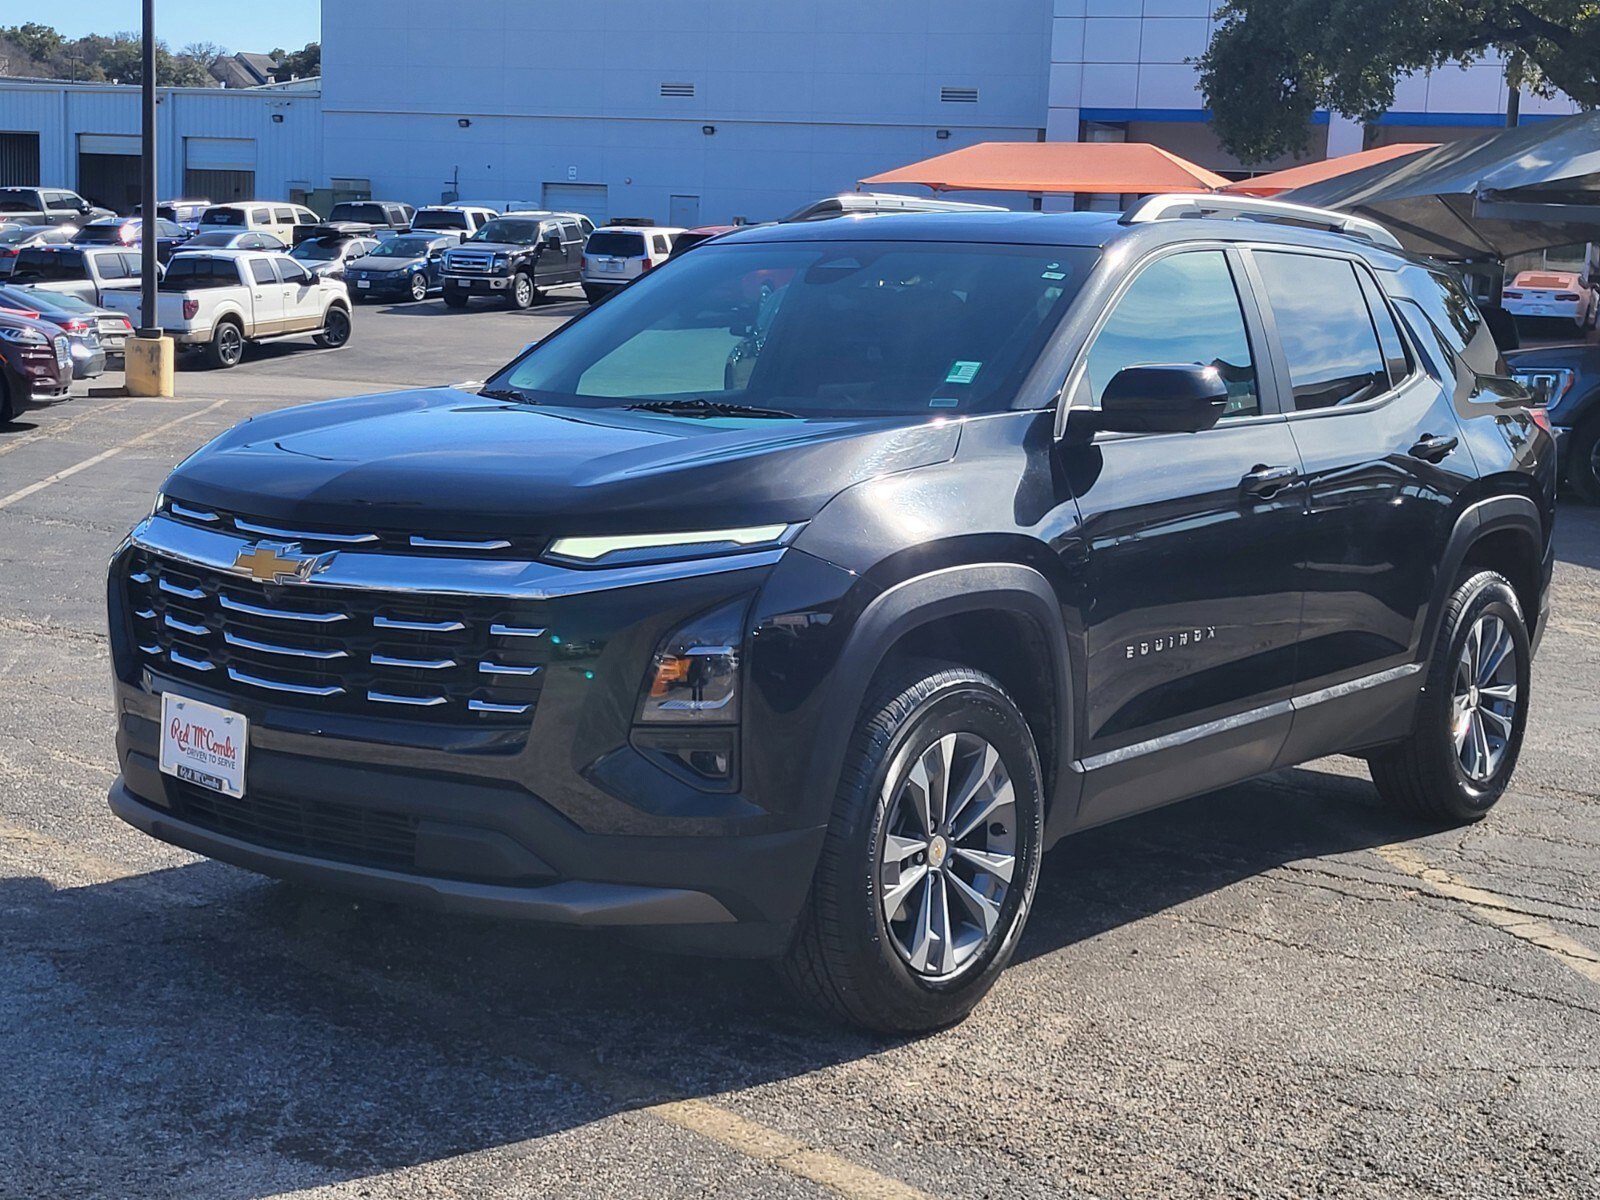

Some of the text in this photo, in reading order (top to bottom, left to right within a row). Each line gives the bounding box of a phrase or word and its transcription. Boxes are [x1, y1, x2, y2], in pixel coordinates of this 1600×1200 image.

[1126, 626, 1216, 659] EQUINOX
[171, 717, 236, 760] Red McCombs
[186, 746, 236, 770] DRIVEN TO SERVE
